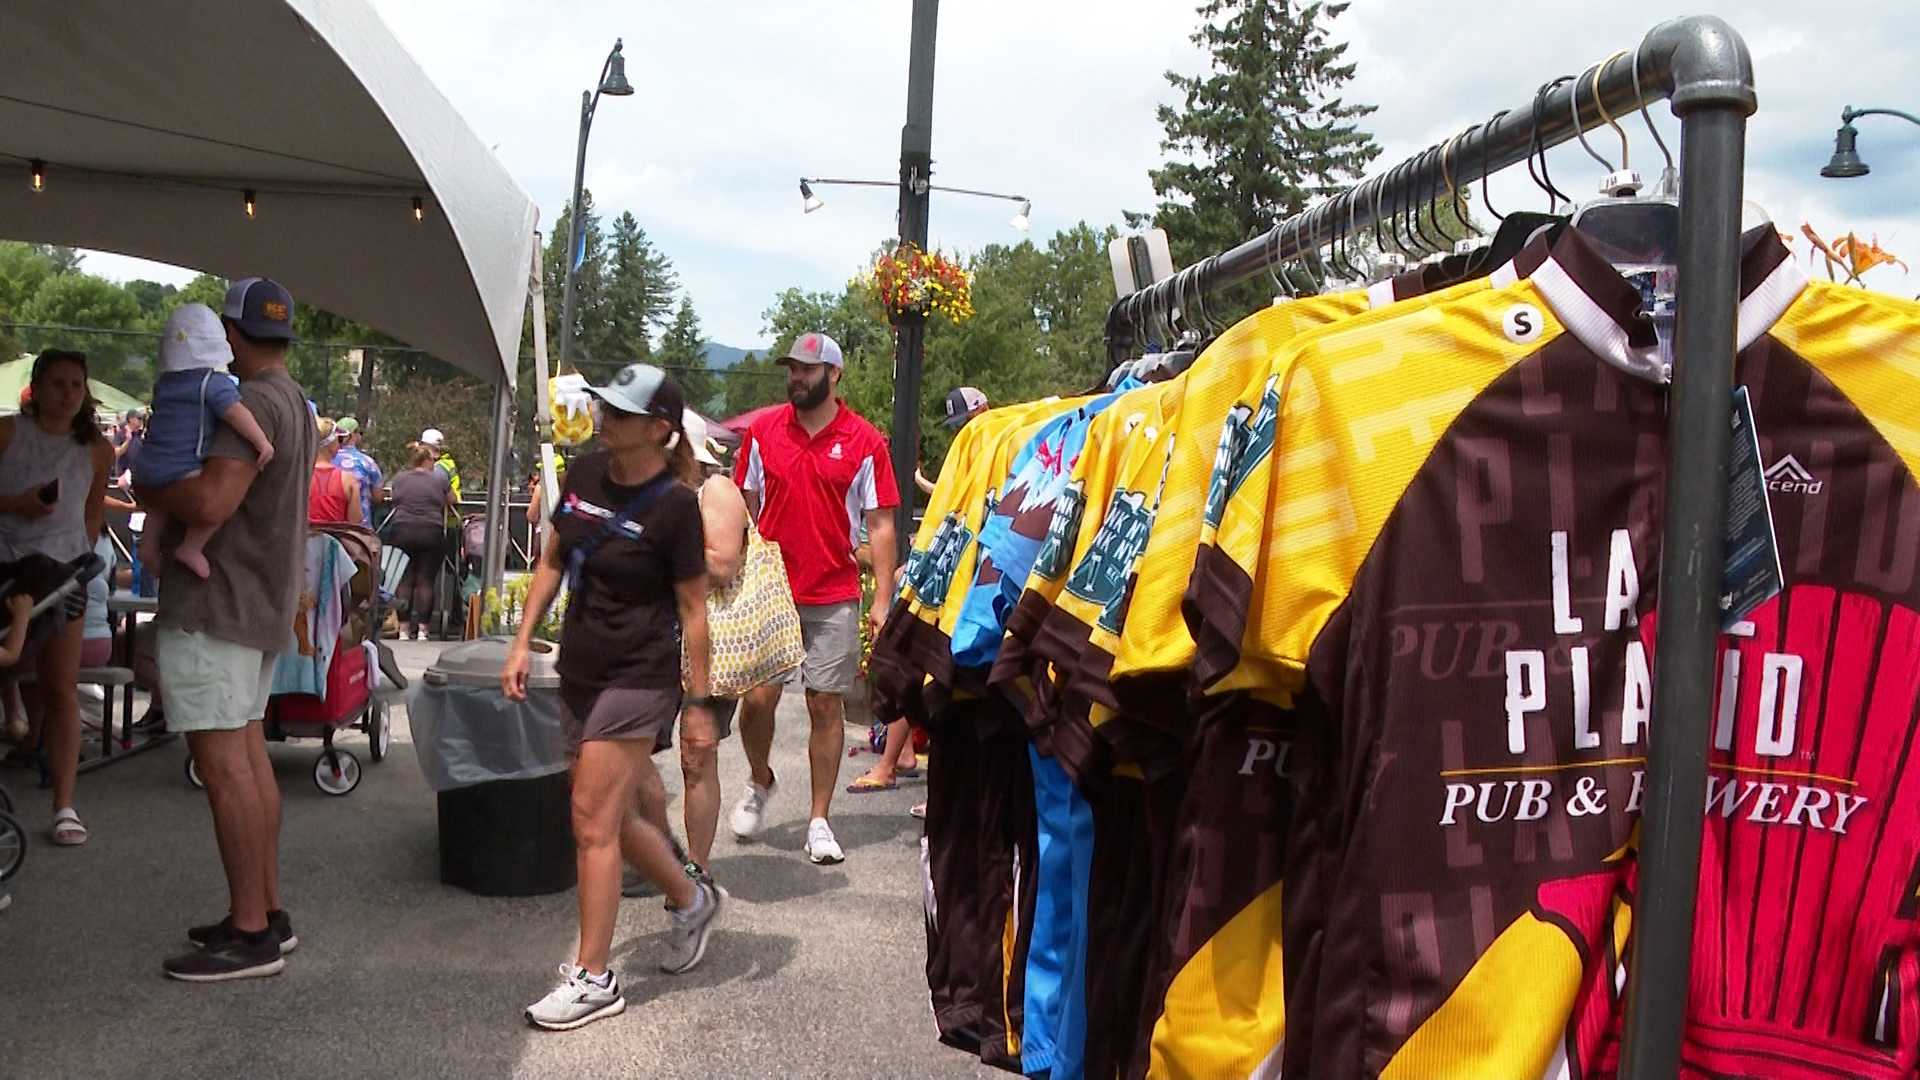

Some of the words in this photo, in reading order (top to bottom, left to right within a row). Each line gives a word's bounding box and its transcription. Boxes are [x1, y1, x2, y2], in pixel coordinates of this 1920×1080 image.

[1514, 311, 1532, 336] S
[1766, 480, 1823, 495] cend
[1505, 641, 1803, 756] PLAID
[1238, 739, 1292, 778] PU
[1439, 779, 1553, 826] PUB
[1566, 776, 1608, 817] &
[1624, 770, 1869, 834] WERY
